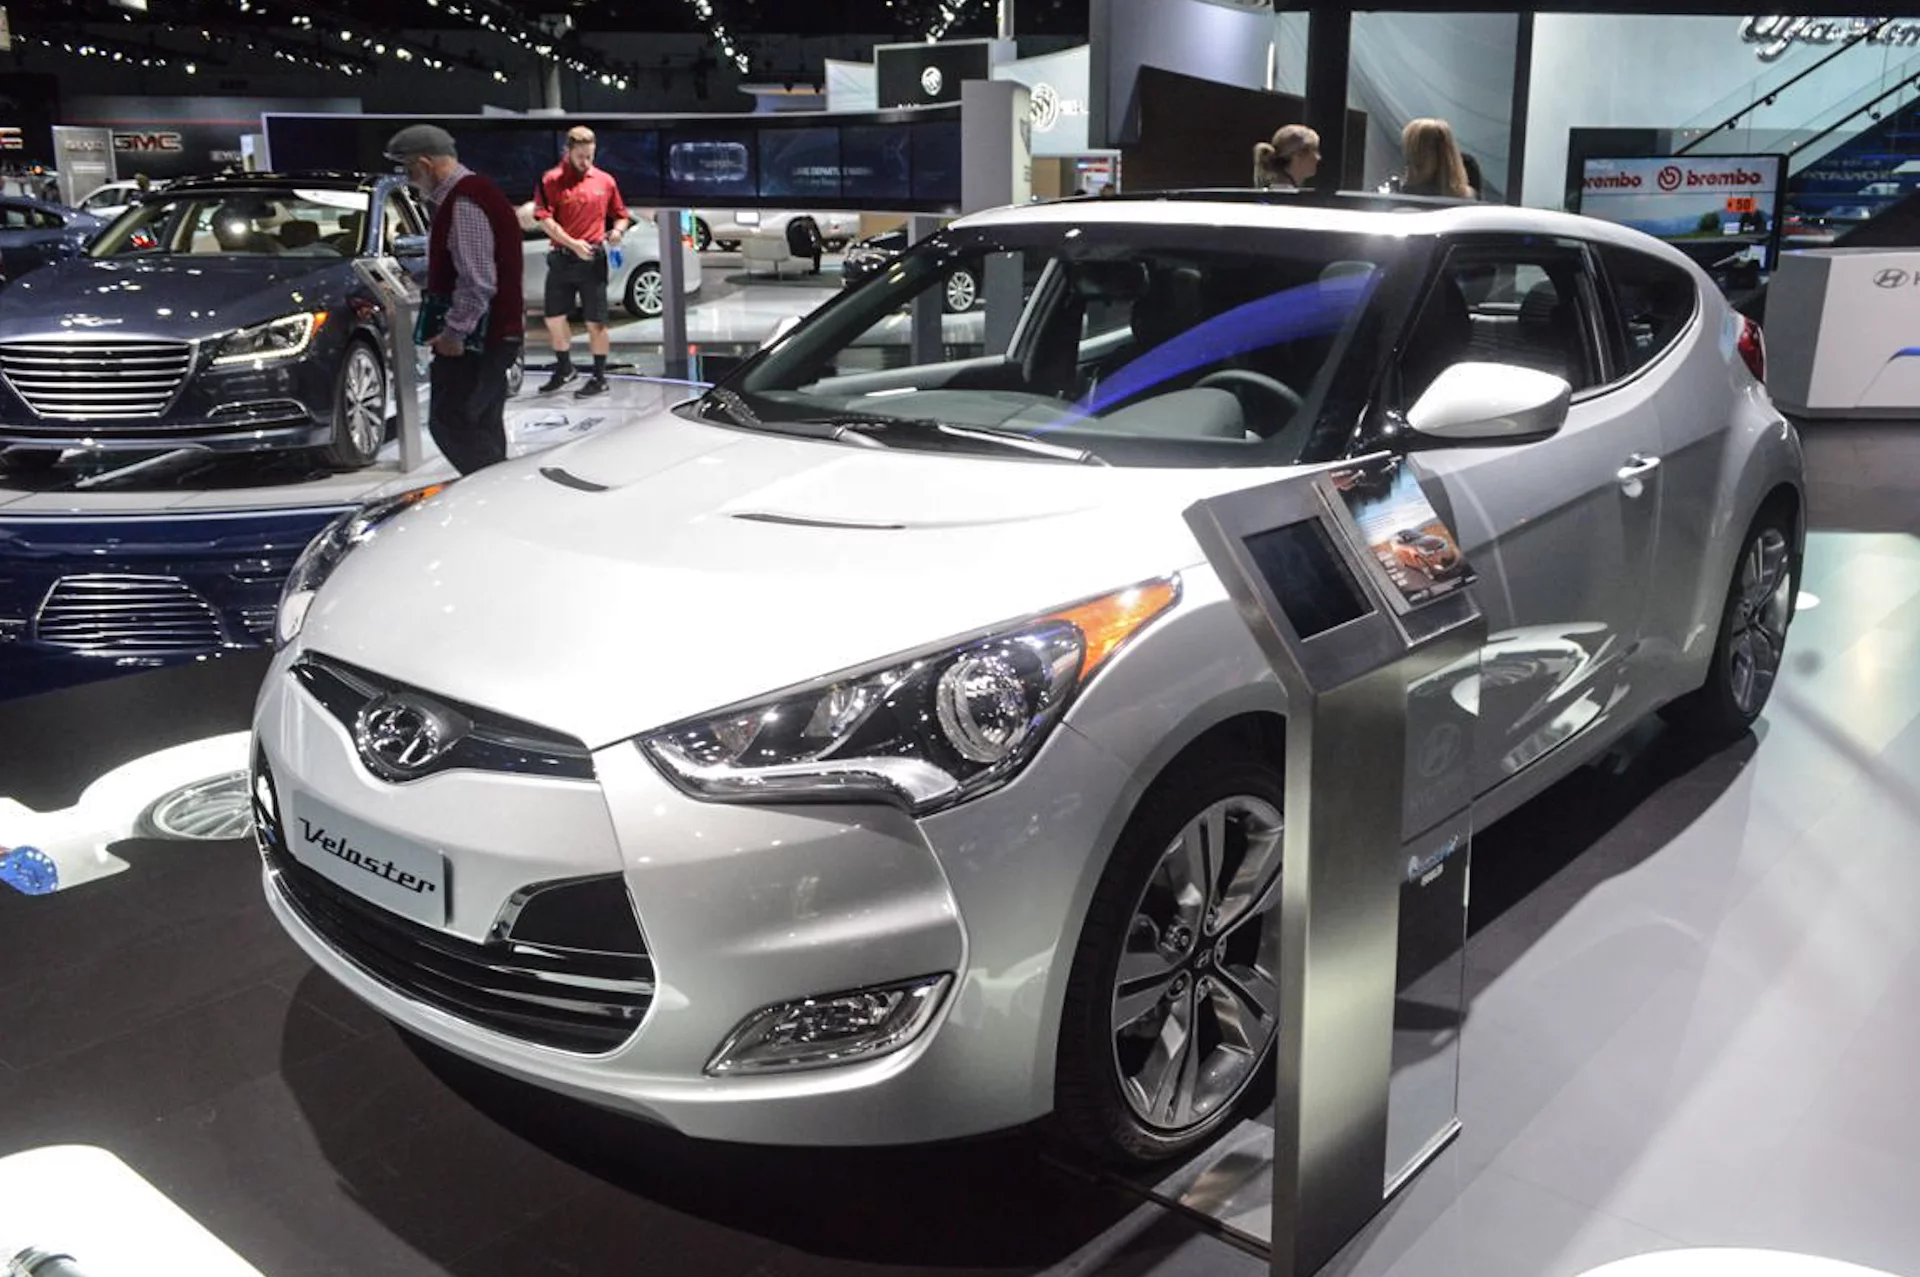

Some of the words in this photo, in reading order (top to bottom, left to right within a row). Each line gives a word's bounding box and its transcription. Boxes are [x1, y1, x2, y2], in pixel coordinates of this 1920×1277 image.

[113, 131, 183, 152] GMC
[1581, 171, 1642, 188] rembo
[1687, 168, 1762, 186] brembo
[299, 816, 436, 893] Veloster
